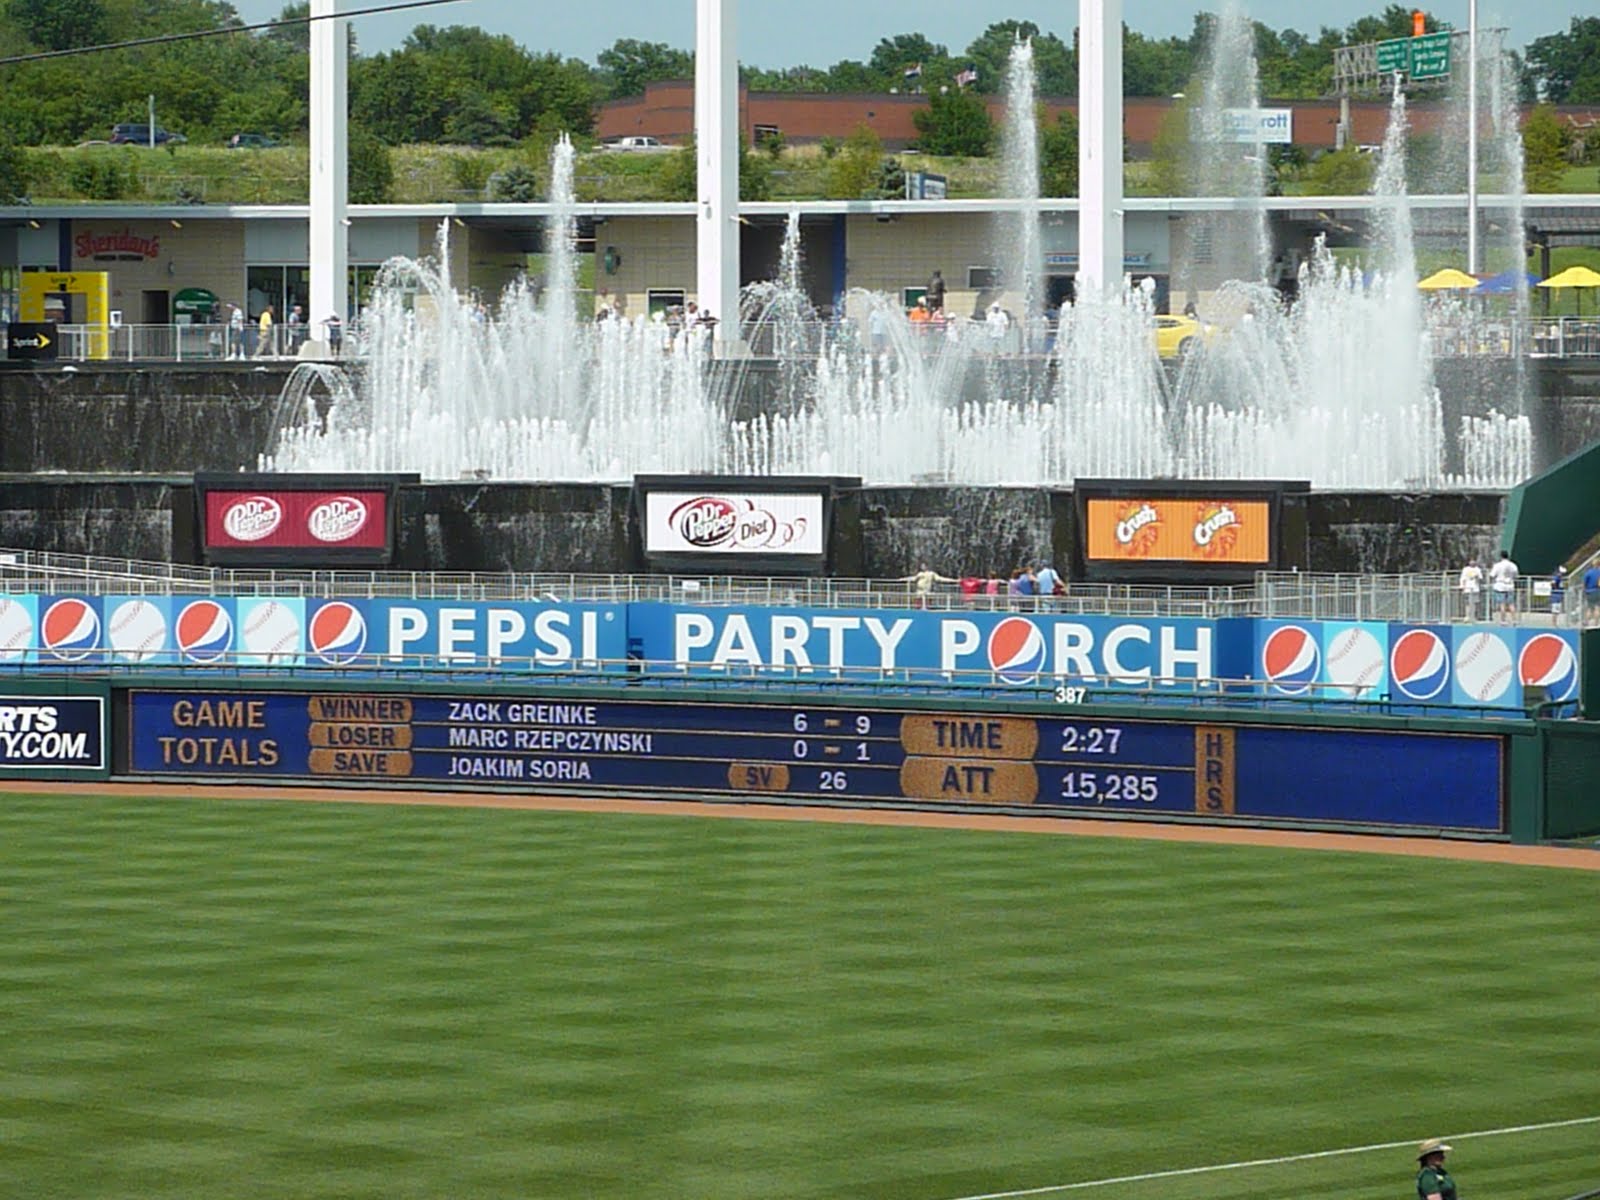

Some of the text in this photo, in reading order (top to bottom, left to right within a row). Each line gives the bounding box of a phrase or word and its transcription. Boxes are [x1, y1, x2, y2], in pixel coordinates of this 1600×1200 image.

[230, 501, 278, 532] Dr Pepper
[314, 501, 363, 534] Dr Pepper
[688, 503, 737, 540] Dr Pepper
[741, 519, 768, 540] Diet
[1116, 504, 1157, 544] Crush
[1194, 505, 1236, 545] Crush
[388, 607, 597, 667] PEPSI
[674, 614, 913, 675] PARTY
[1055, 687, 1086, 703] 387
[173, 700, 265, 728] GAME
[319, 699, 405, 722] WINNER
[448, 703, 597, 725] ZACK GREINKE
[327, 726, 396, 748] LOSER
[793, 713, 808, 732] 6
[855, 716, 871, 735] 9
[933, 720, 1003, 749] TIME
[0, 732, 87, 758] Y.COM
[158, 737, 279, 765] TOTALS
[449, 729, 652, 753] MARC RZEPCZYNSKI
[793, 740, 808, 759] 0
[856, 743, 871, 761] 1
[1062, 726, 1121, 754] 2:27
[334, 752, 388, 773] SAVE
[448, 757, 591, 780] JOAKIM SORIA
[746, 767, 848, 790] SV 26
[941, 766, 994, 793] ATT
[1062, 772, 1158, 804] 15,285
